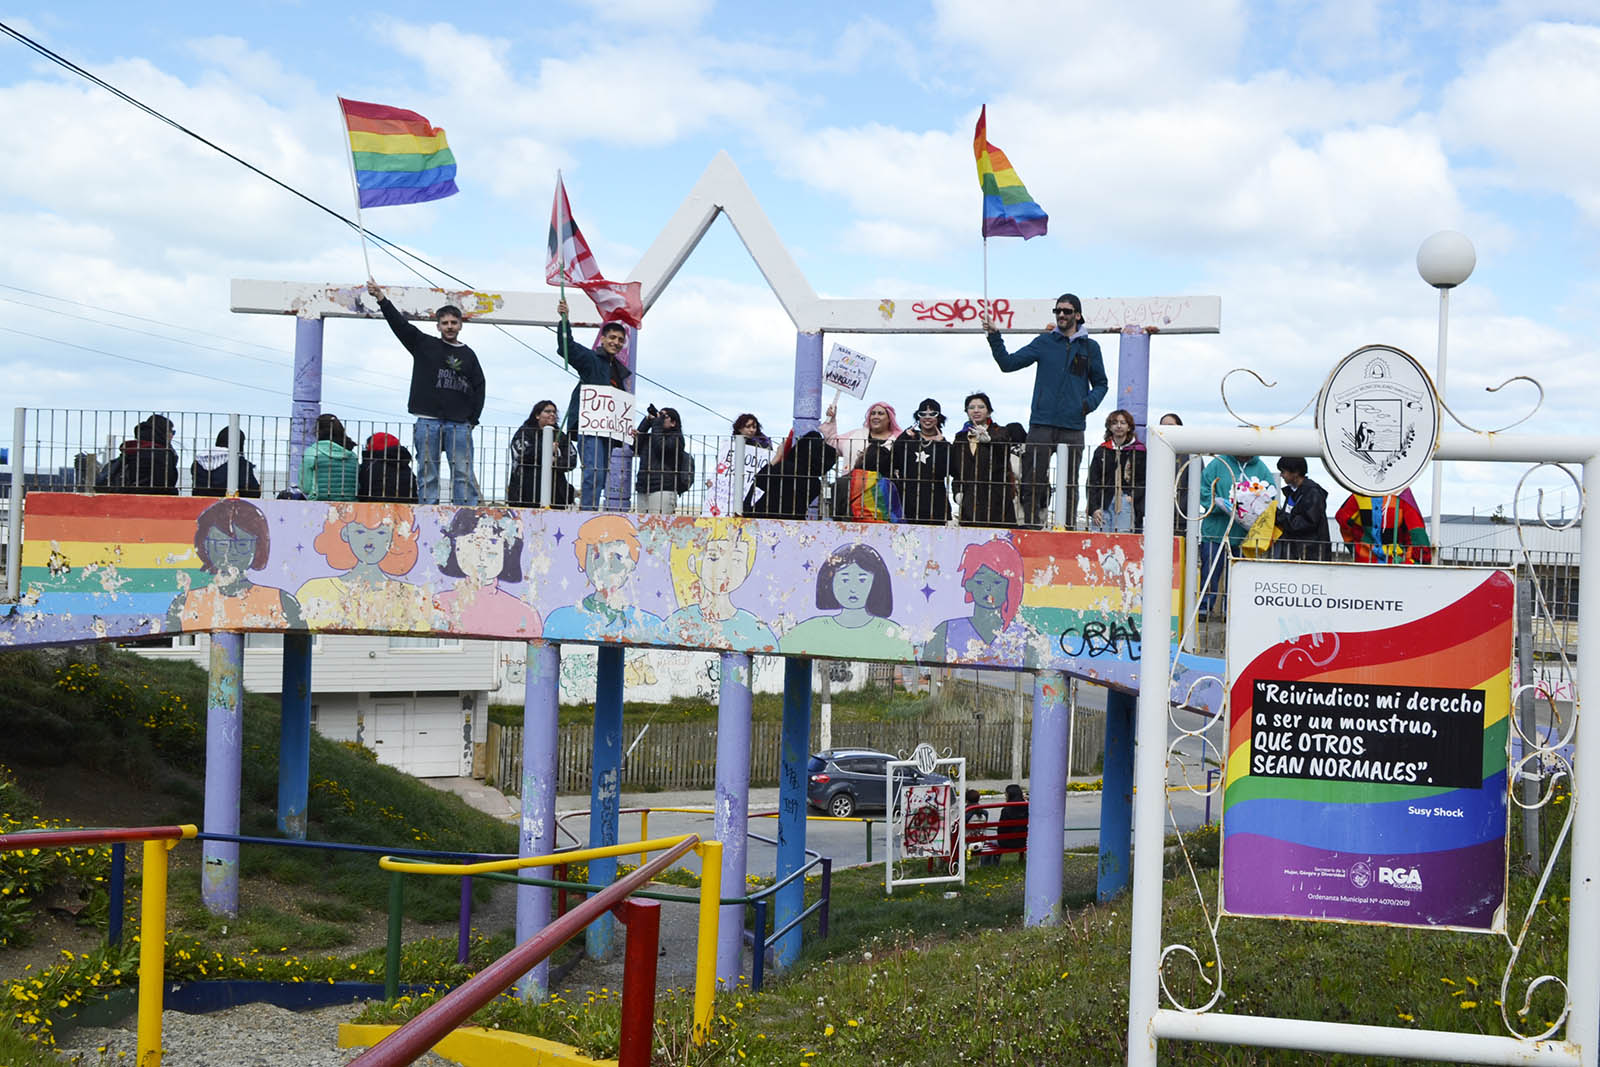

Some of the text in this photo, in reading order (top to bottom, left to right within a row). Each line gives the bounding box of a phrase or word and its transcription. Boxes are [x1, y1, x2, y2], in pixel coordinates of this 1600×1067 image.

[1254, 582, 1327, 596] PASEO DEL
[1254, 595, 1403, 612] ORGULLO DISIDENTE
[1256, 682, 1483, 714] “Reivindico: mi derecho
[1255, 713, 1438, 739] a ser un monstruo,
[1254, 731, 1365, 756] QUE OTROS
[1253, 755, 1304, 776] SEAN
[1408, 805, 1464, 819] Susy Shock
[1378, 866, 1422, 885] RGA
[1307, 893, 1339, 902] Ordenanza
[1340, 895, 1369, 904] Municipal
